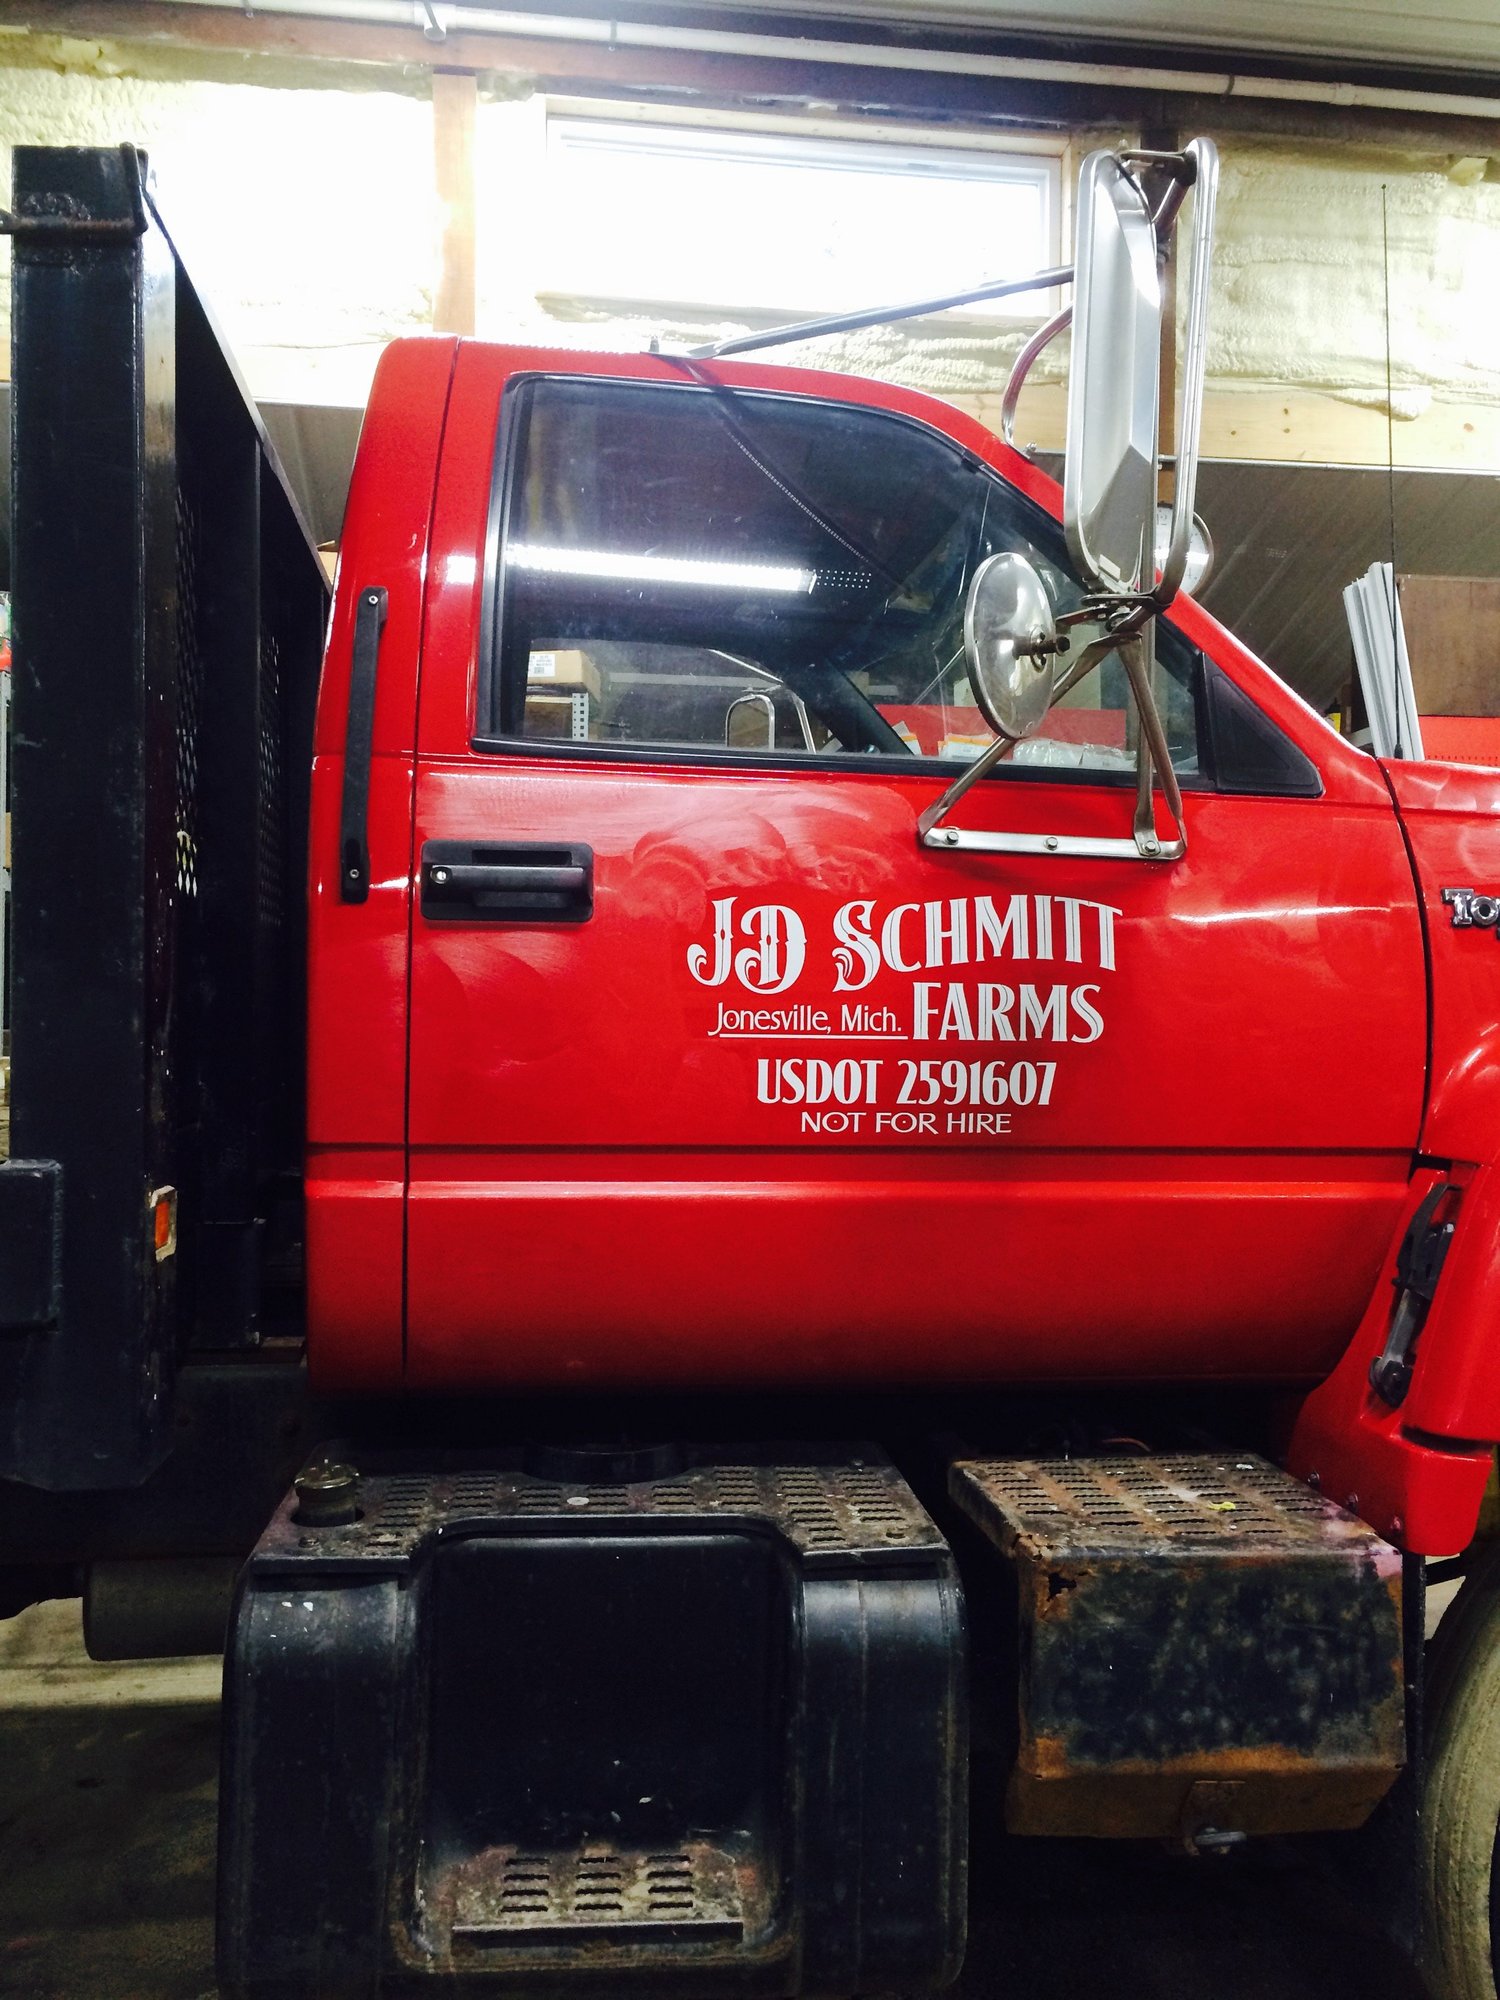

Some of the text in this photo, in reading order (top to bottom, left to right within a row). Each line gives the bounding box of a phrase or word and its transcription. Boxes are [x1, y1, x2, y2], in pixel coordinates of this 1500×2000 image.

[1441, 888, 1500, 935] To
[686, 894, 1123, 995] JD SCHMITT
[707, 1002, 902, 1036] Jonesville, Mich.
[912, 981, 1104, 1043] FARMS
[757, 1058, 1057, 1106] USDOT 2591607
[801, 1111, 1012, 1135] NOT FOR HIRE
